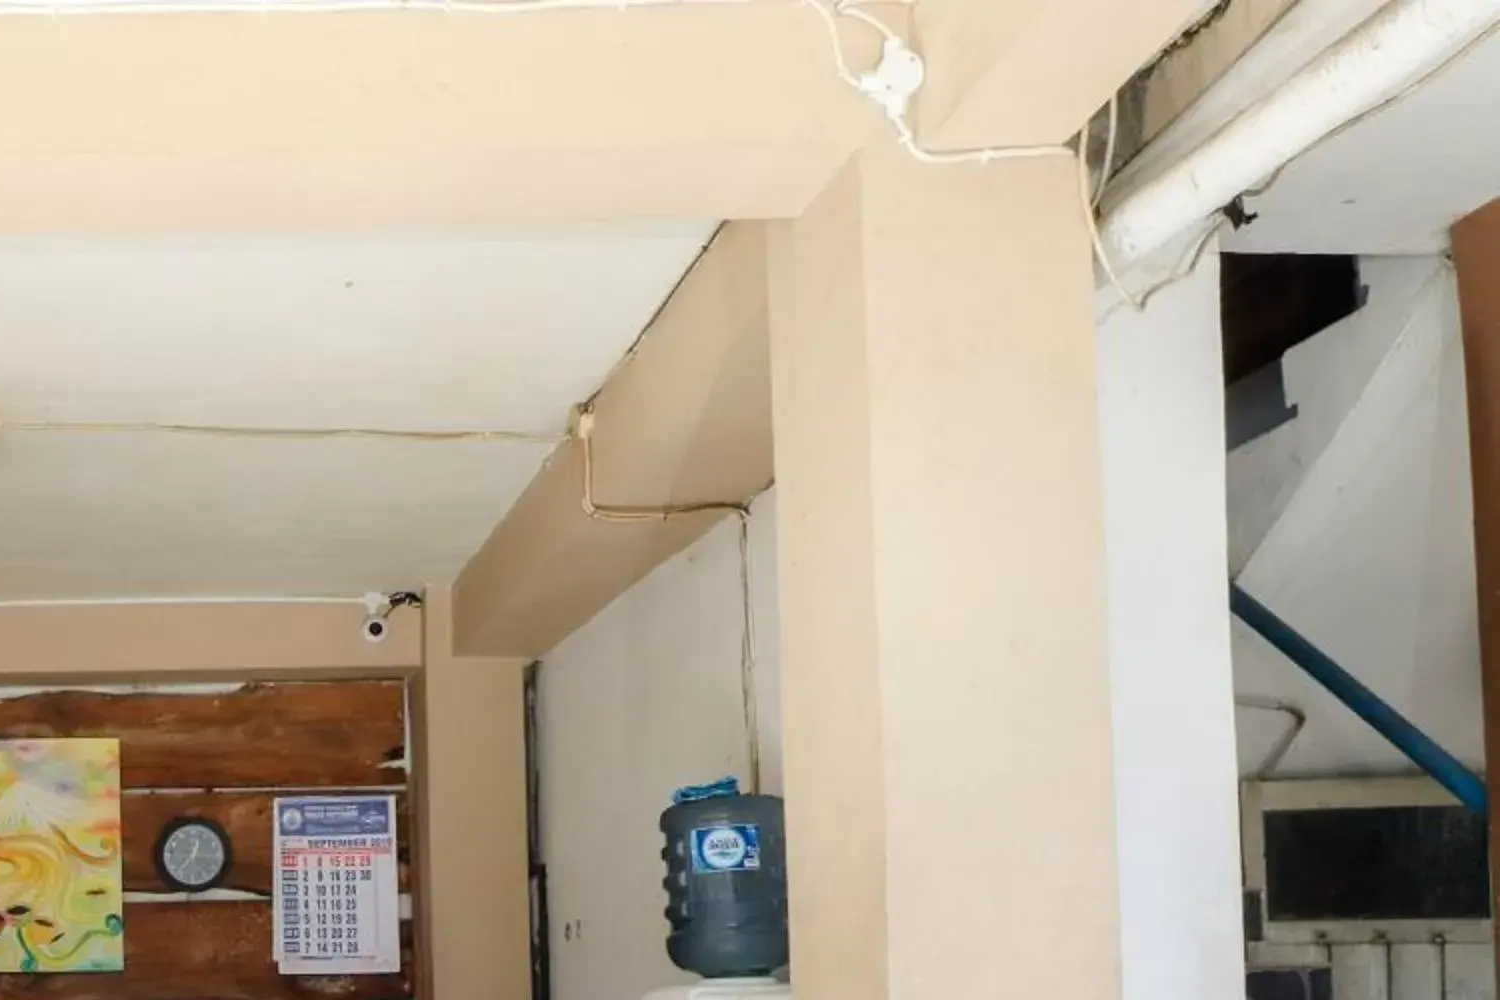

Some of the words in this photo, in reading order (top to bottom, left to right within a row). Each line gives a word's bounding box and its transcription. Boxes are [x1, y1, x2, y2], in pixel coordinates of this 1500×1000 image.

[307, 838, 367, 849] SEPTEMBER
[303, 856, 308, 867] 1
[330, 856, 341, 867] 15
[303, 870, 309, 881] 2
[345, 870, 357, 881] 23
[359, 870, 372, 881] 30
[316, 884, 327, 896] 10
[330, 884, 341, 896] 17
[345, 884, 357, 896] 24
[303, 899, 309, 911] 4
[317, 899, 327, 911] 11
[345, 899, 357, 911] 25
[304, 913, 310, 925] 5
[317, 913, 327, 925] 12
[331, 913, 342, 925] 19
[346, 913, 358, 925] 26
[317, 927, 327, 939] 13
[331, 927, 343, 939] 20
[346, 927, 358, 939] 27
[305, 942, 311, 953] 7
[317, 942, 328, 953] 14
[332, 942, 343, 953] 21
[347, 942, 359, 953] 28
